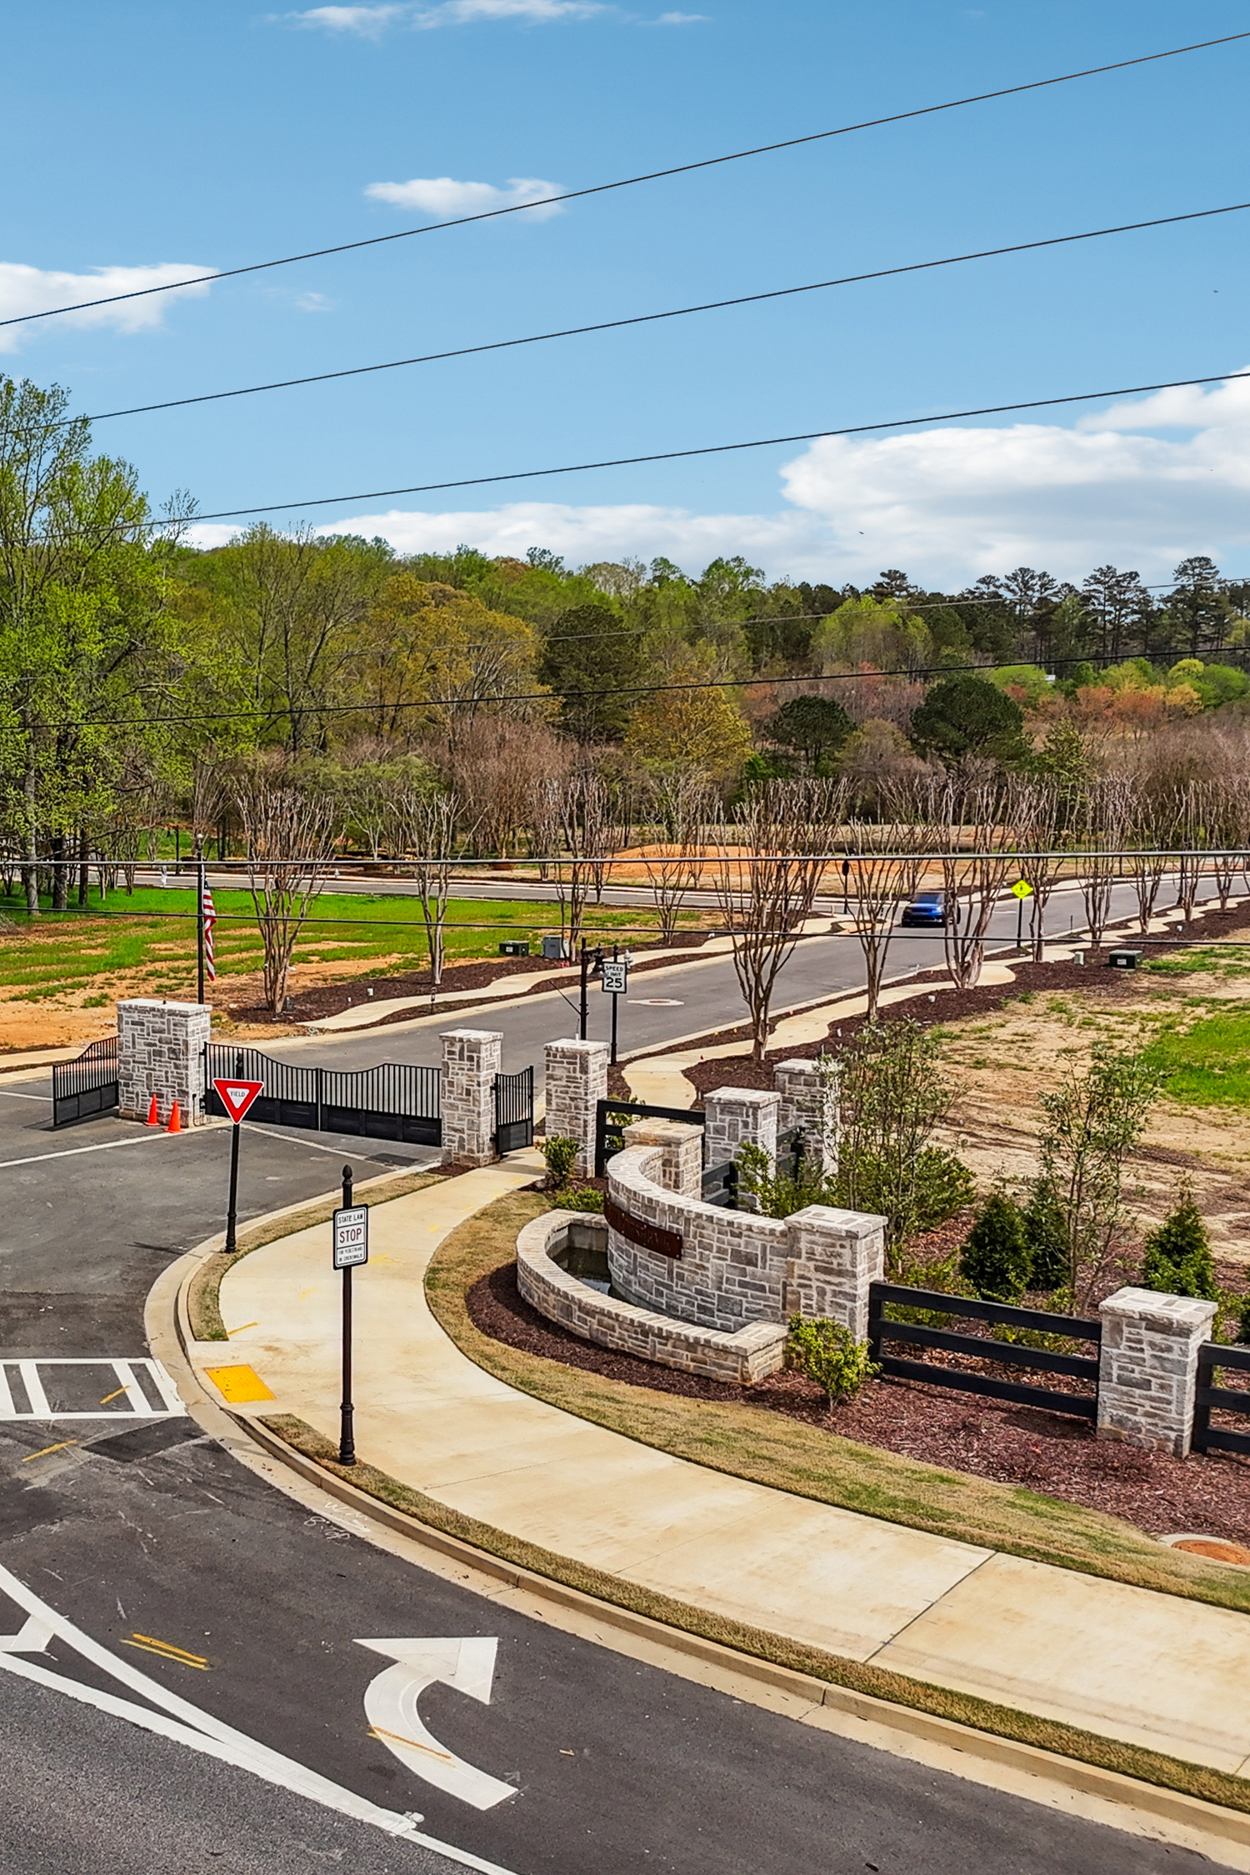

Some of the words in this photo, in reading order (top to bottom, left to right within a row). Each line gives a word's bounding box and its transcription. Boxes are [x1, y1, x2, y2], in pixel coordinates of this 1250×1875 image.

[606, 977, 623, 988] 25
[338, 1215, 352, 1224] STATE
[353, 1213, 363, 1221] LAW
[339, 1227, 362, 1244] STOP
